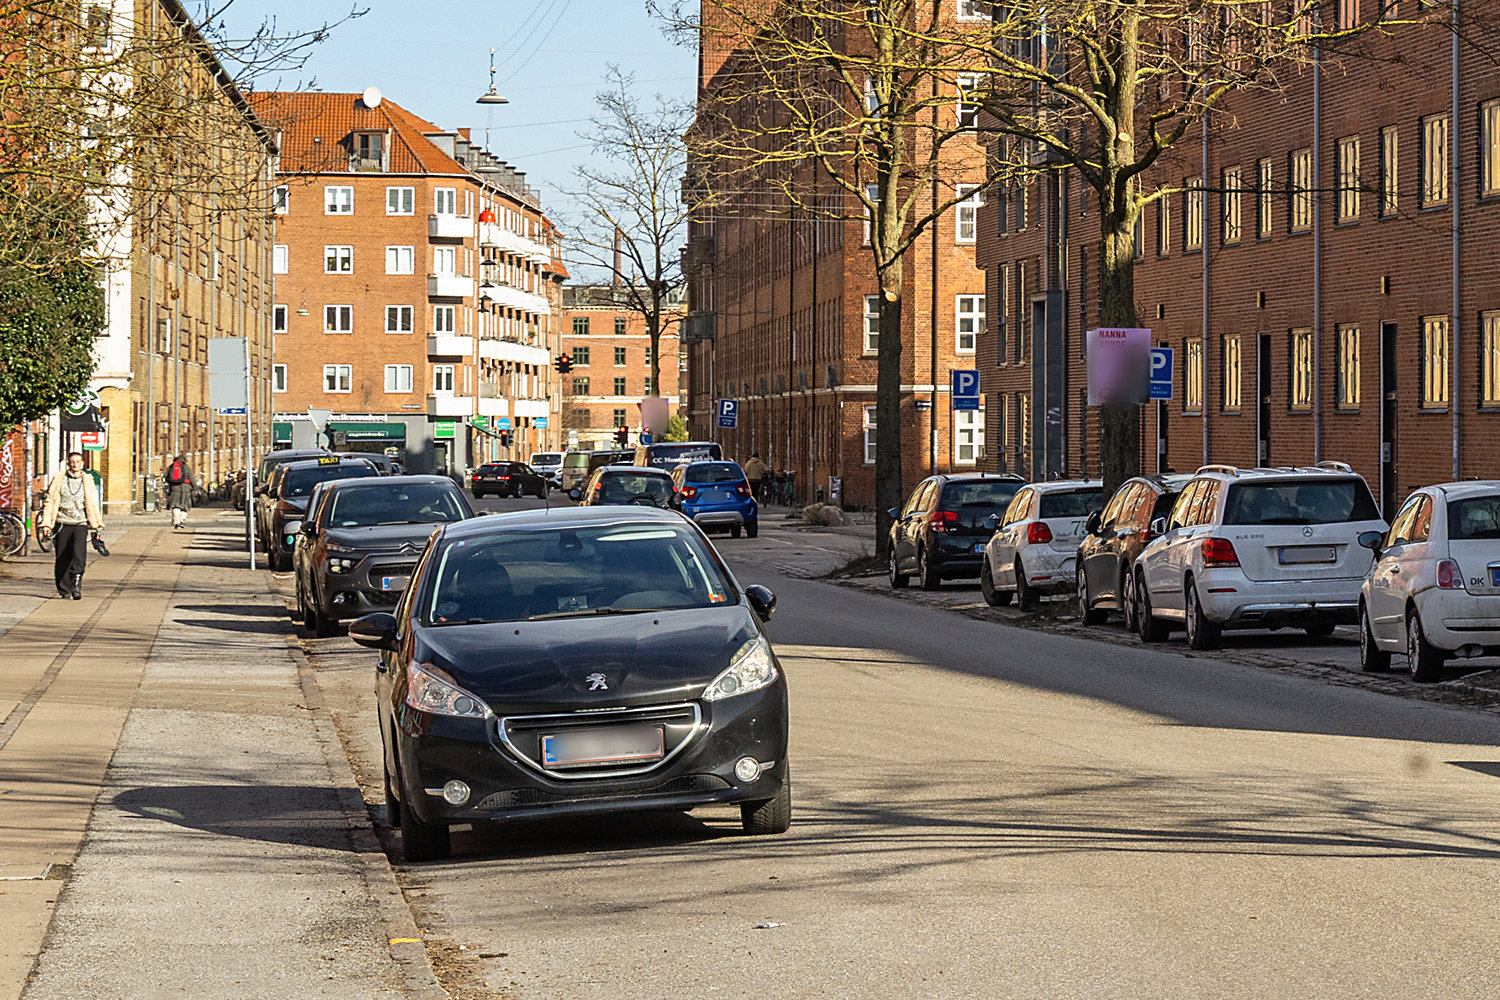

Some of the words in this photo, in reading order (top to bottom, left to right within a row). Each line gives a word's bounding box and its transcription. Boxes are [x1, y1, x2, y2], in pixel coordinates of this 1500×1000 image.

[1099, 330, 1127, 339] NANNA
[1150, 352, 1166, 377] P
[959, 373, 974, 393] P
[723, 401, 734, 415] P
[1470, 577, 1485, 586] DK
